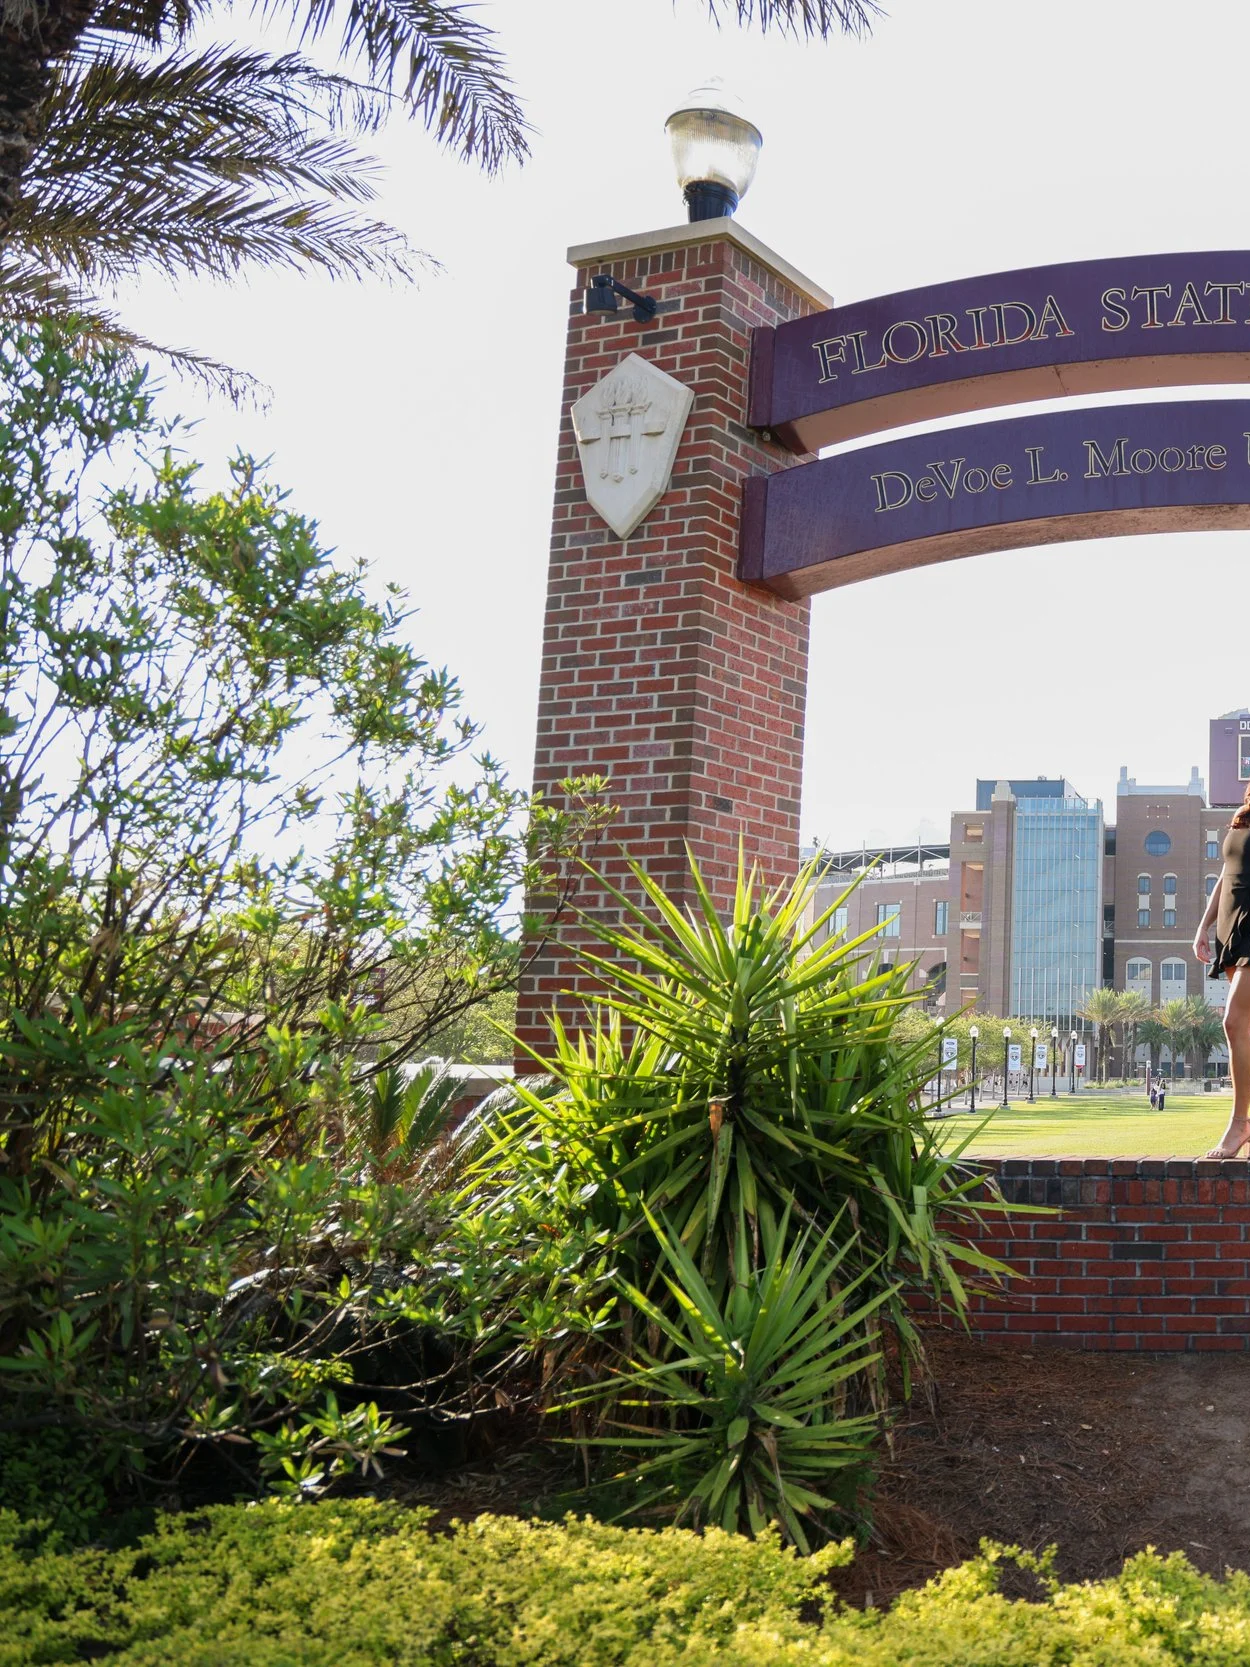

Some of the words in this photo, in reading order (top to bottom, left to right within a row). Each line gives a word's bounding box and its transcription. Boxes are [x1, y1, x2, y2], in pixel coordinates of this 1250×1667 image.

[812, 295, 1075, 384] FLORIDA
[871, 457, 1013, 513] DeVoe
[1025, 446, 1068, 485] L.
[1083, 438, 1227, 480] Moore
